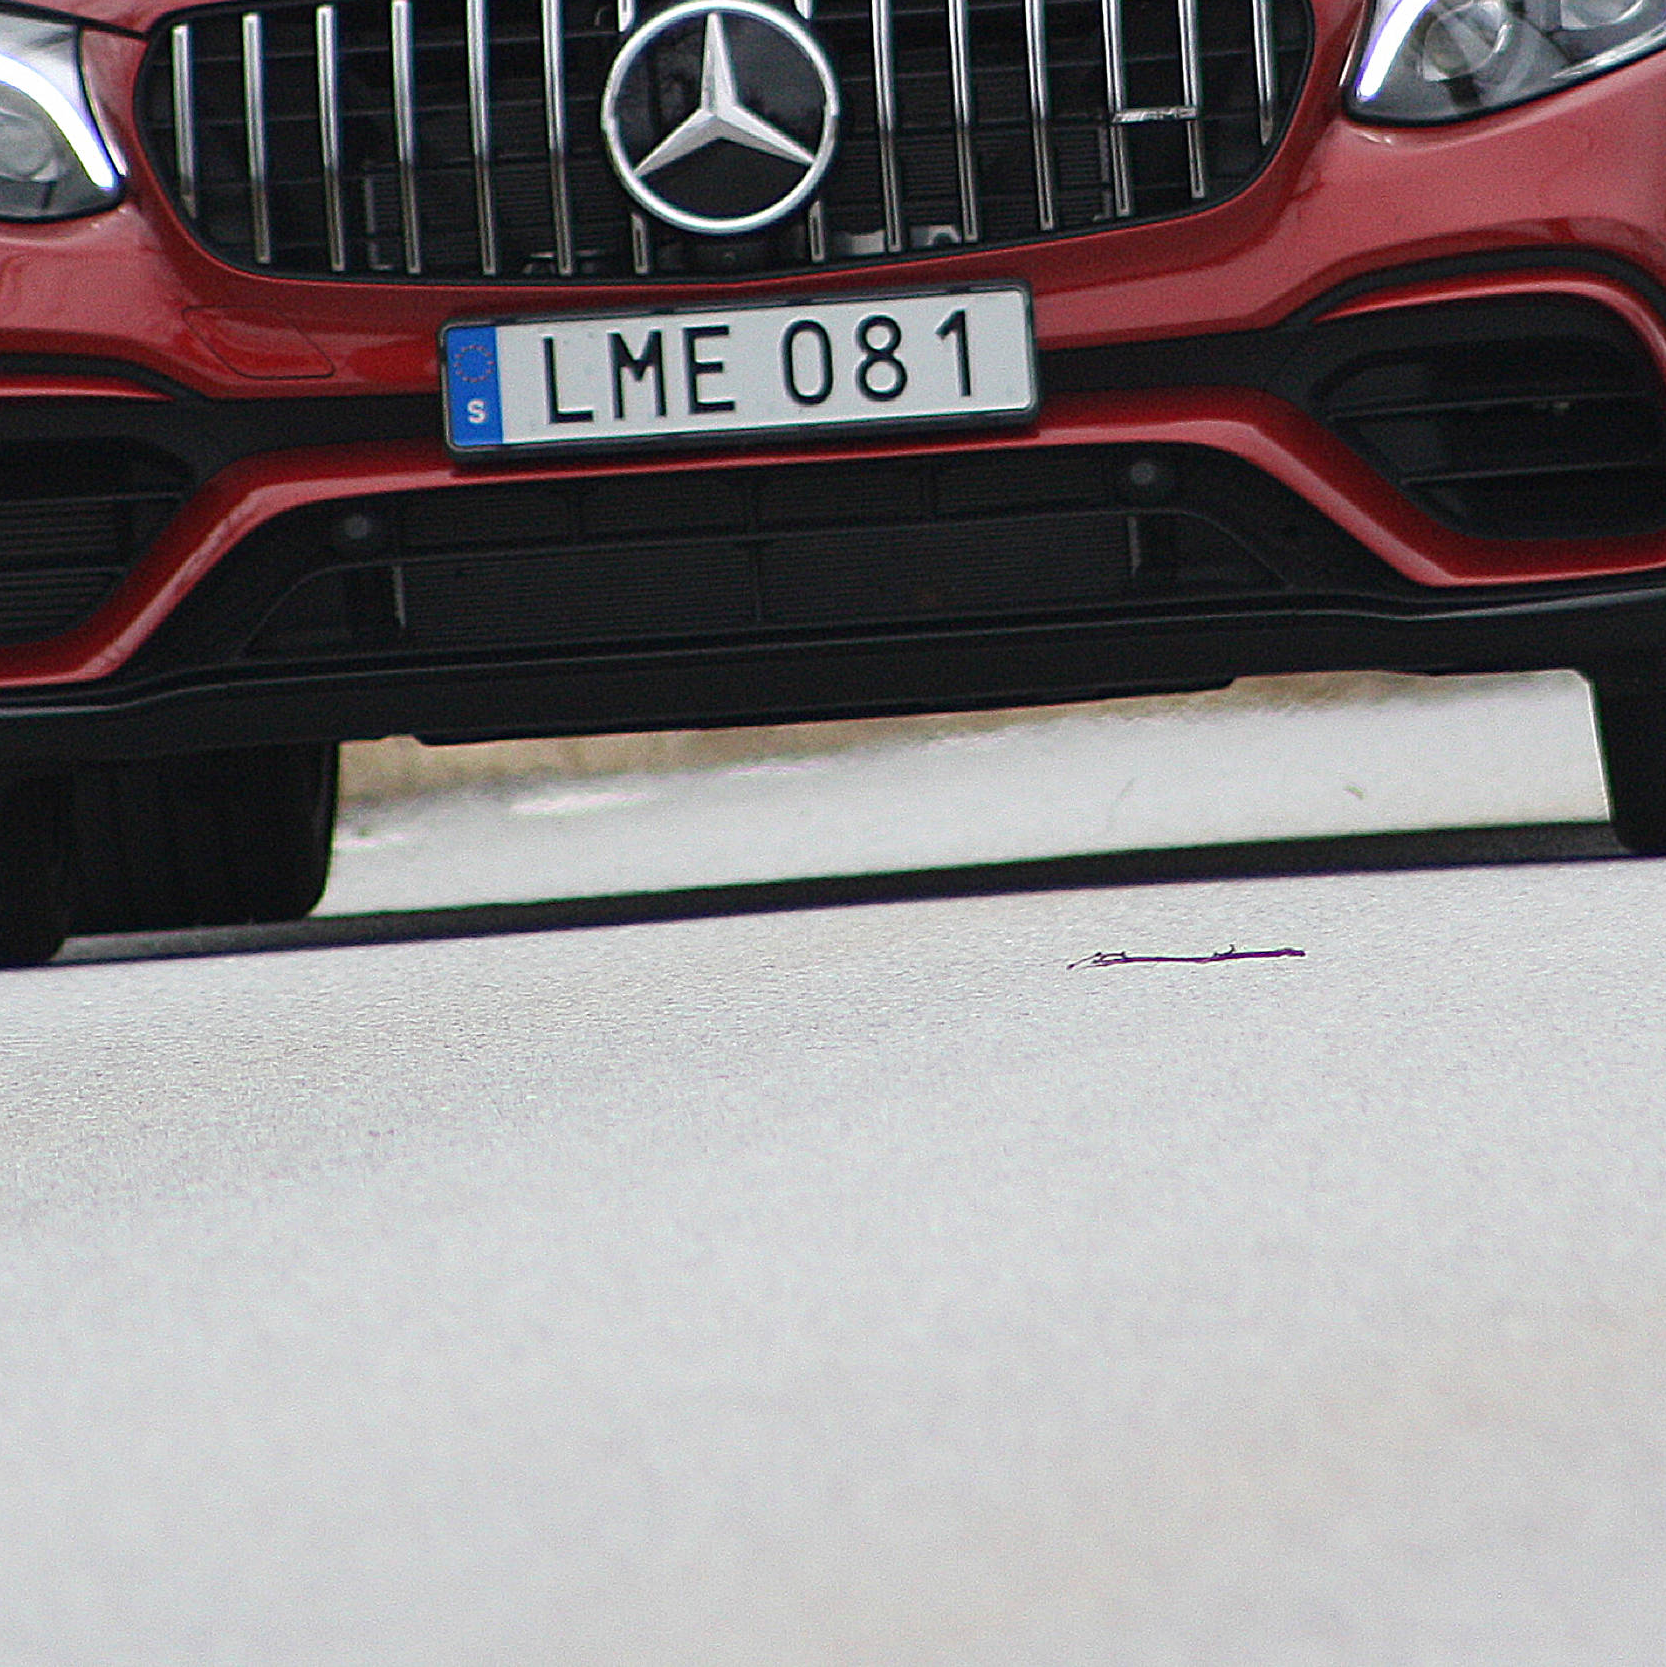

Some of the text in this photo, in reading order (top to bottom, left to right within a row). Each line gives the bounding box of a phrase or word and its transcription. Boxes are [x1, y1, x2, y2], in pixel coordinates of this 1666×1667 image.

[542, 308, 973, 425] LME 081
[467, 398, 486, 425] S
